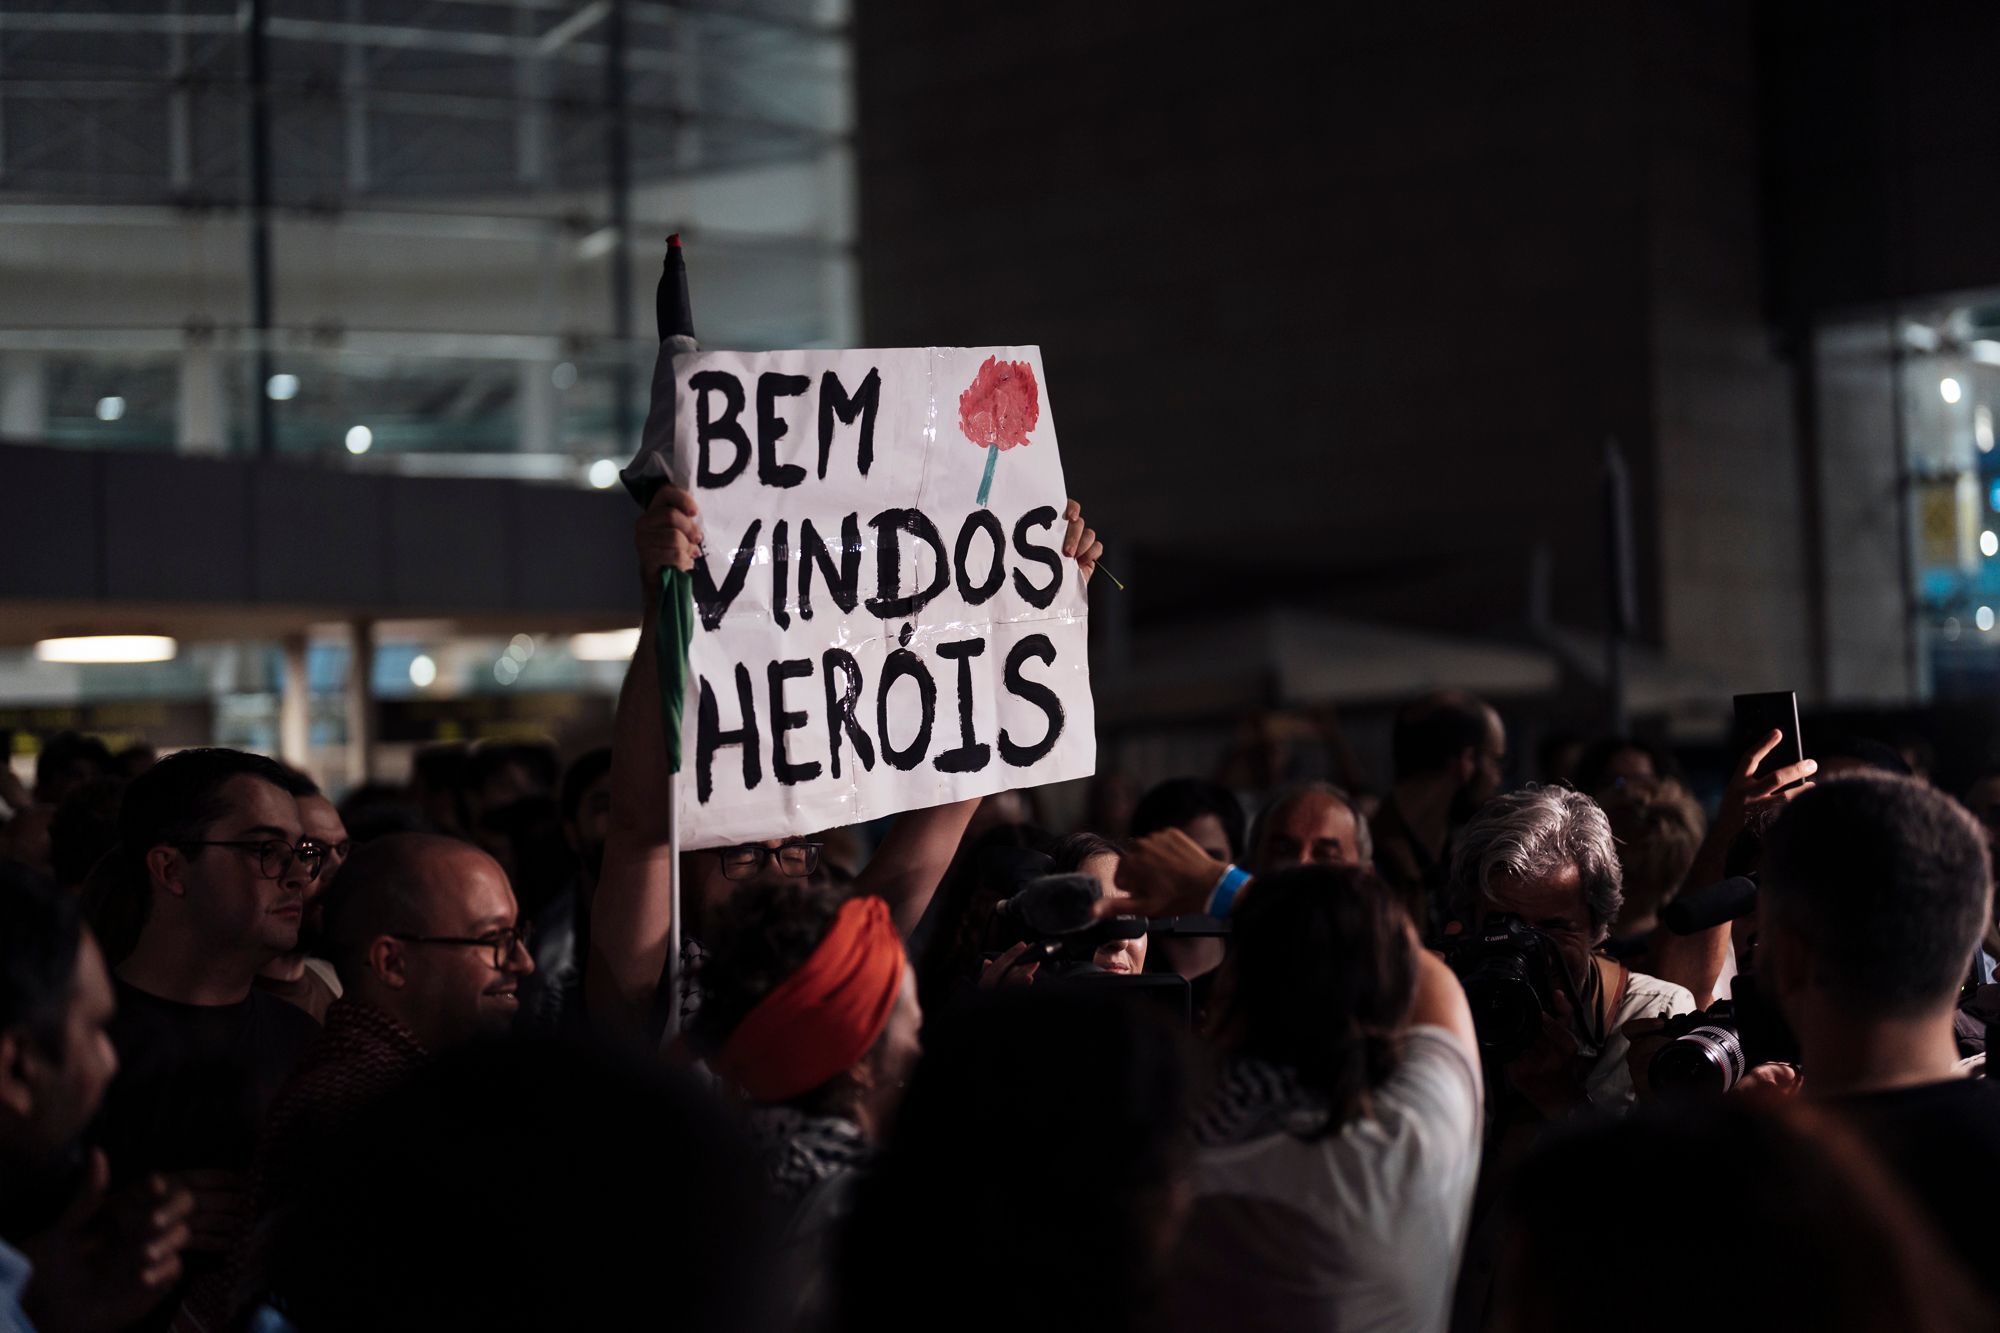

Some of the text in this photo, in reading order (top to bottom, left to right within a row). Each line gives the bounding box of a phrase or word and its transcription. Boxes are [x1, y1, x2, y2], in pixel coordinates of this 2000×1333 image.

[689, 366, 882, 489] BEM
[692, 505, 1065, 632] VINDOS
[696, 621, 1066, 805] HERÓIS
